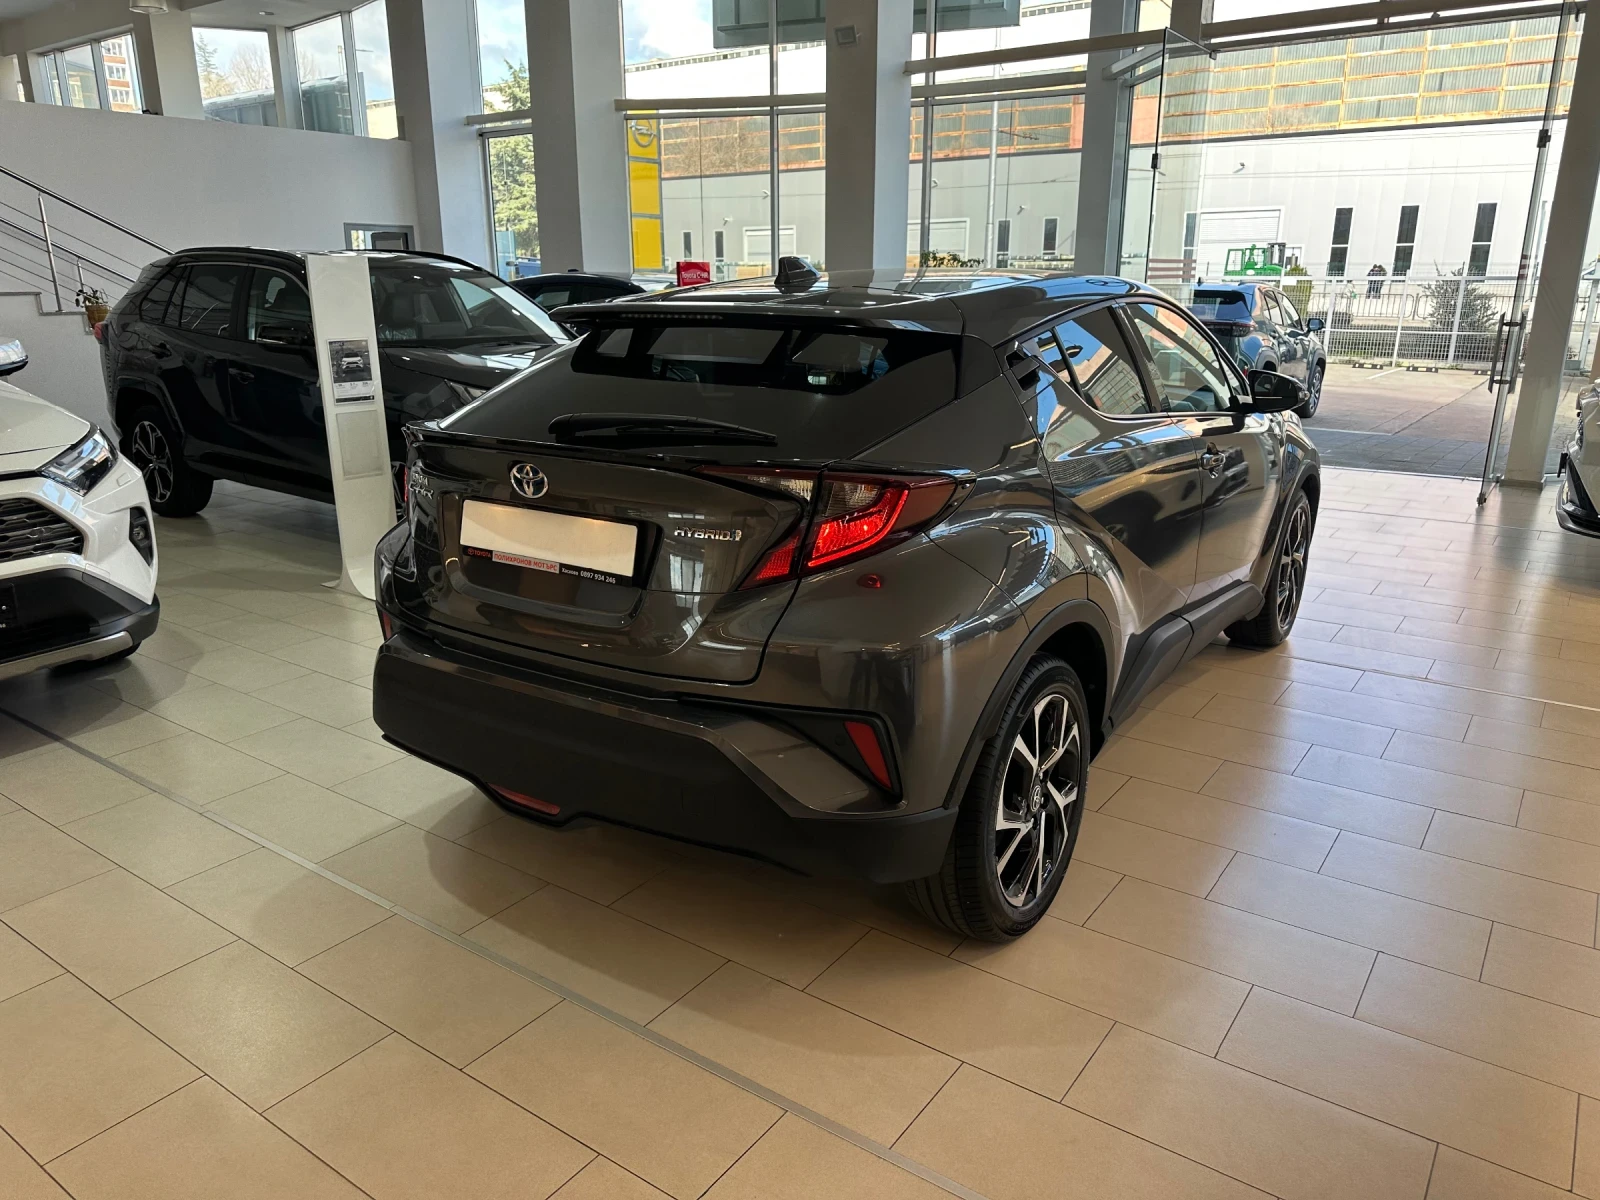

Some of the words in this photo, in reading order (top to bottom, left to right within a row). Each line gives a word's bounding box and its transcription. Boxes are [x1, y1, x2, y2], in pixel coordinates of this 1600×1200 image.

[674, 526, 731, 541] HYBRID
[474, 550, 492, 558] TOYOTA
[494, 553, 532, 567] ПОЛИХРОНОВ
[533, 560, 558, 572] МОТЪРС
[580, 570, 594, 579] 0897
[594, 573, 605, 582] 934
